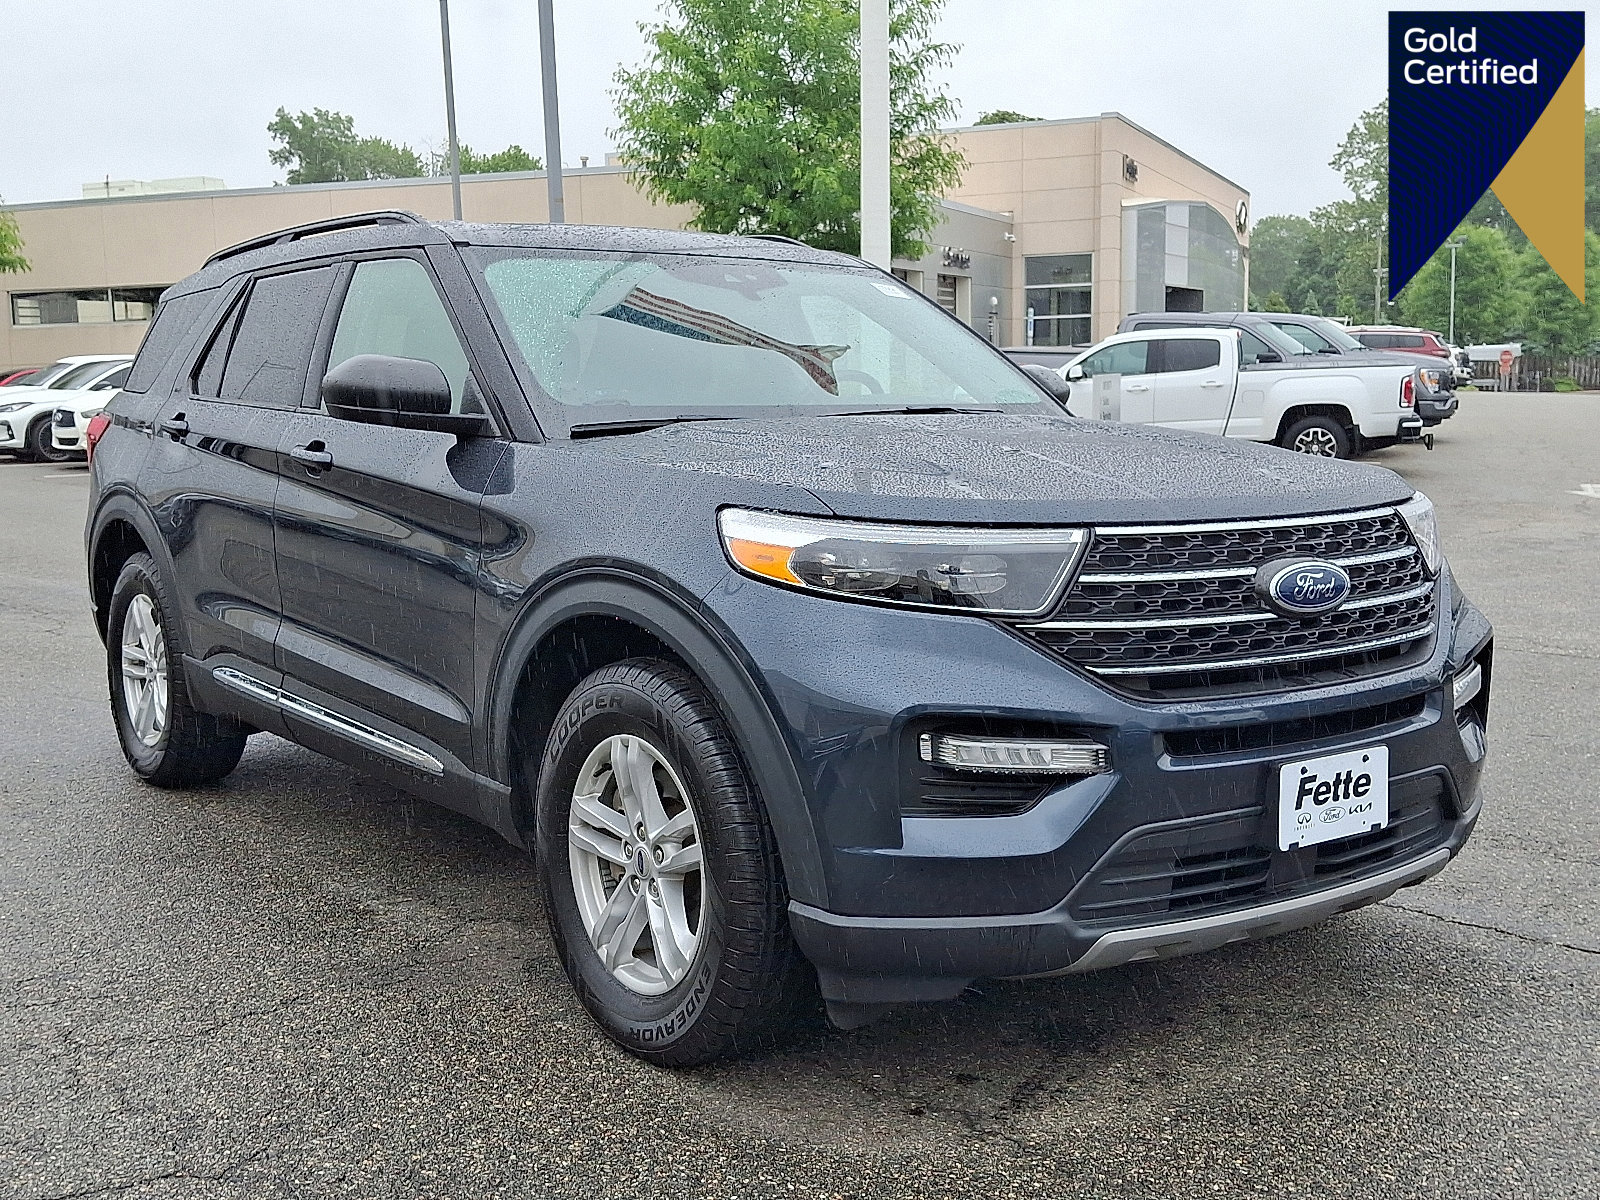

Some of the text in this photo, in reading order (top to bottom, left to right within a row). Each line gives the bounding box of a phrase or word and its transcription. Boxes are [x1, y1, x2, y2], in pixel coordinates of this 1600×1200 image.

[1293, 571, 1336, 601] Ford
[549, 693, 624, 763] COOPER
[1295, 769, 1372, 811] Fette
[1323, 808, 1342, 822] Ford
[629, 961, 712, 1042] ENDEAVOR
